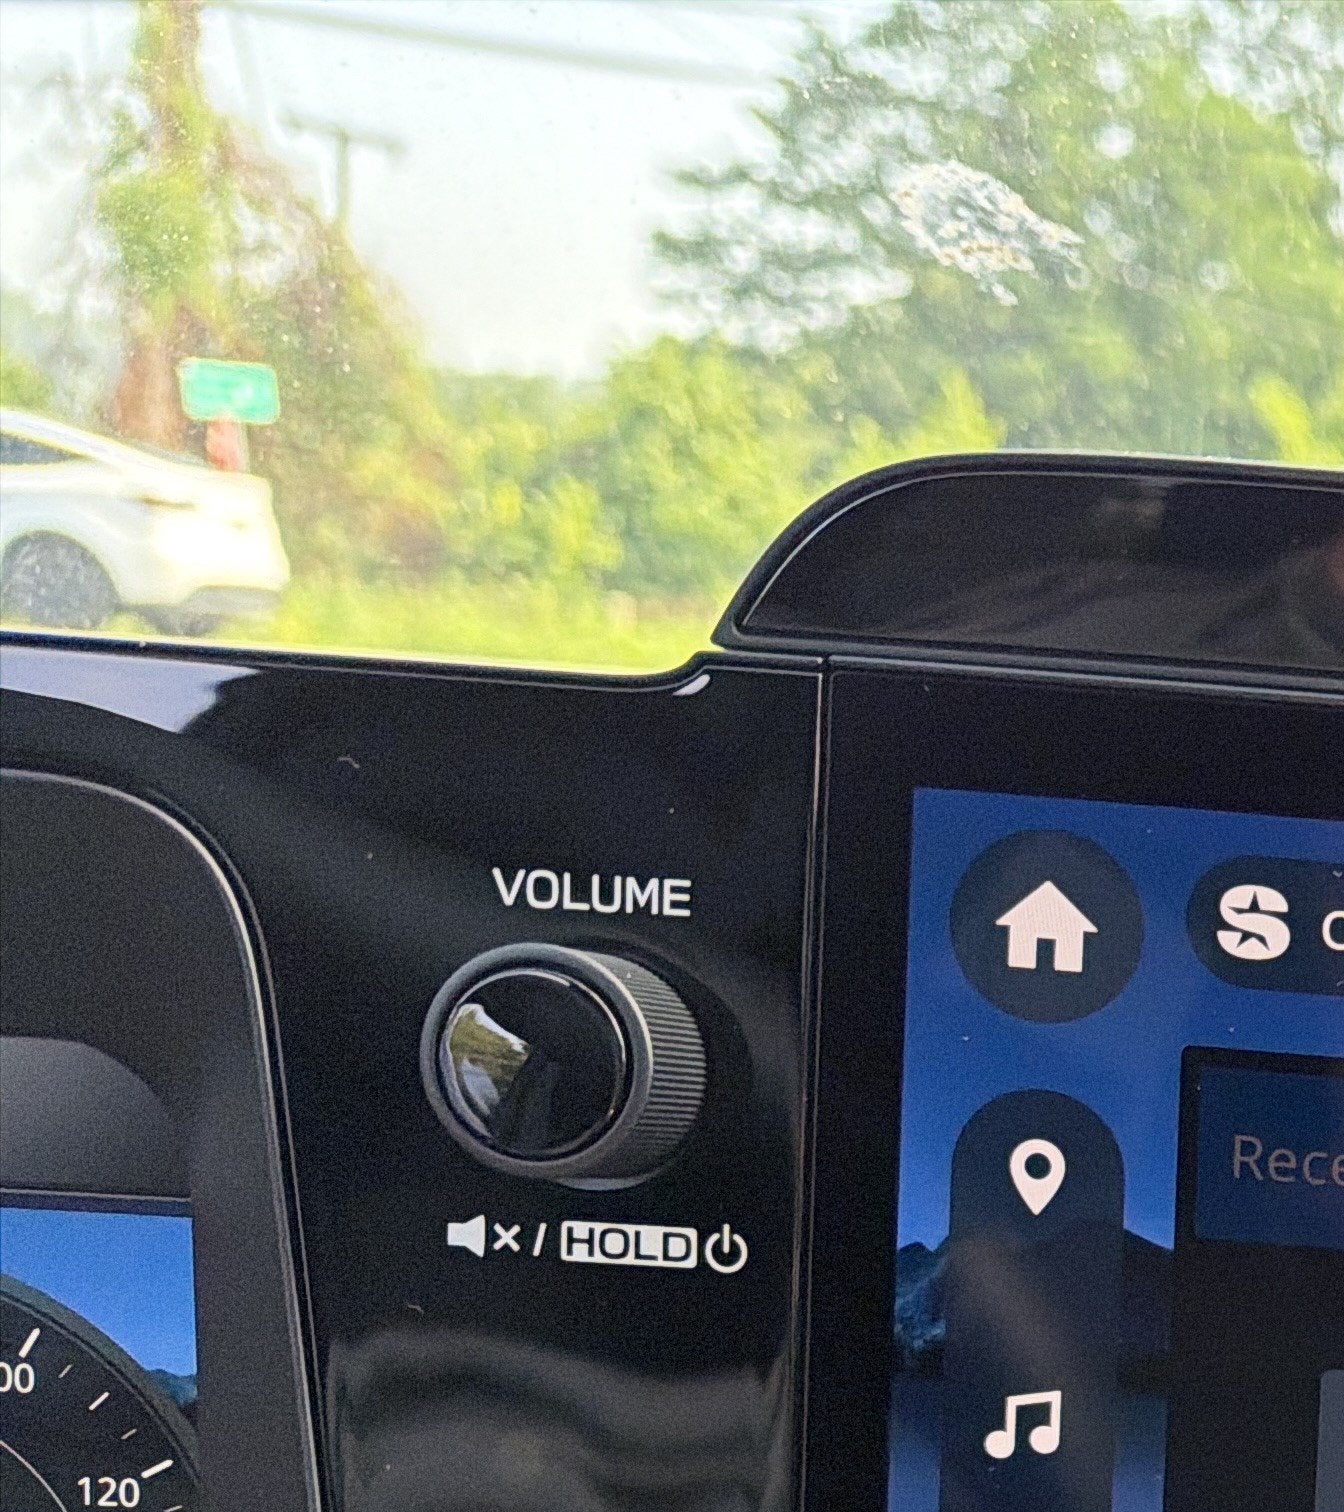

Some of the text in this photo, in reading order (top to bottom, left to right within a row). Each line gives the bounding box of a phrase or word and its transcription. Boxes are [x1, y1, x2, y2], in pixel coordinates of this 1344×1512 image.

[491, 867, 692, 917] VOLUME
[565, 1226, 693, 1263] HOLD
[77, 1476, 141, 1508] 120
